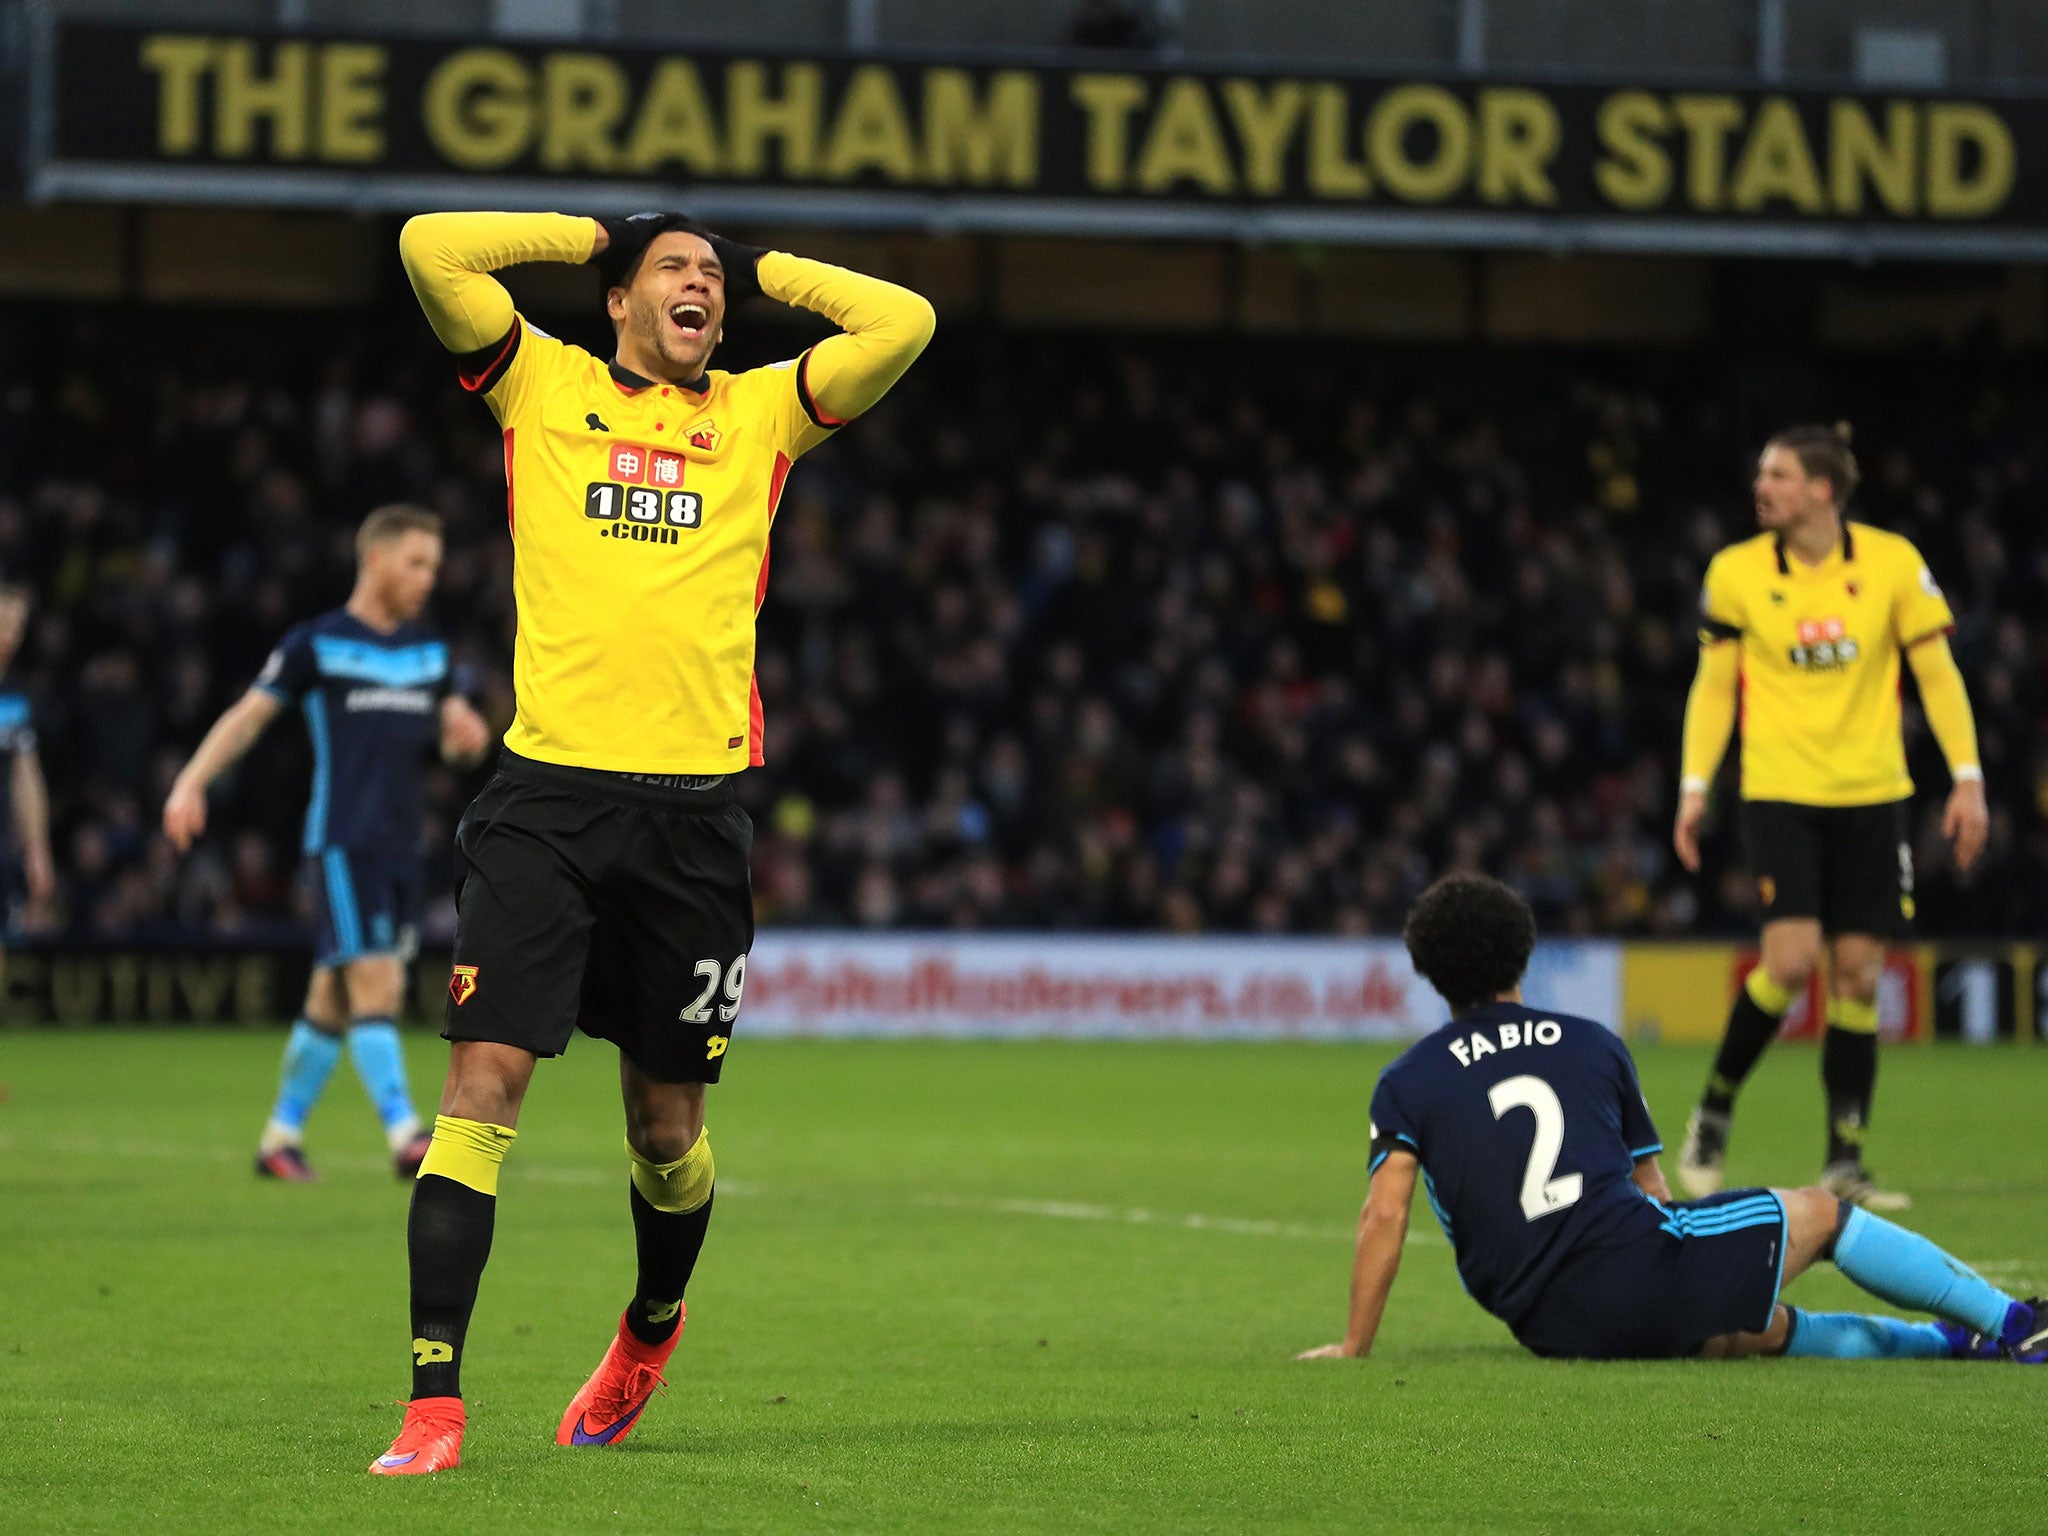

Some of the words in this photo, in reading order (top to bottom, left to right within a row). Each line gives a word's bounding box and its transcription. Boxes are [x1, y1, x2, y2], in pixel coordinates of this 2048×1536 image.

[142, 36, 386, 162] THE
[425, 49, 1039, 186] GRAHAM
[1071, 75, 1560, 205] TAYLOR
[1594, 87, 2014, 217] STAND
[616, 451, 680, 485] 申博
[590, 486, 698, 525] 138
[600, 523, 679, 545] .com
[678, 953, 747, 1024] 29
[1448, 1020, 1562, 1068] FABIO
[1487, 1074, 1583, 1223] 2
